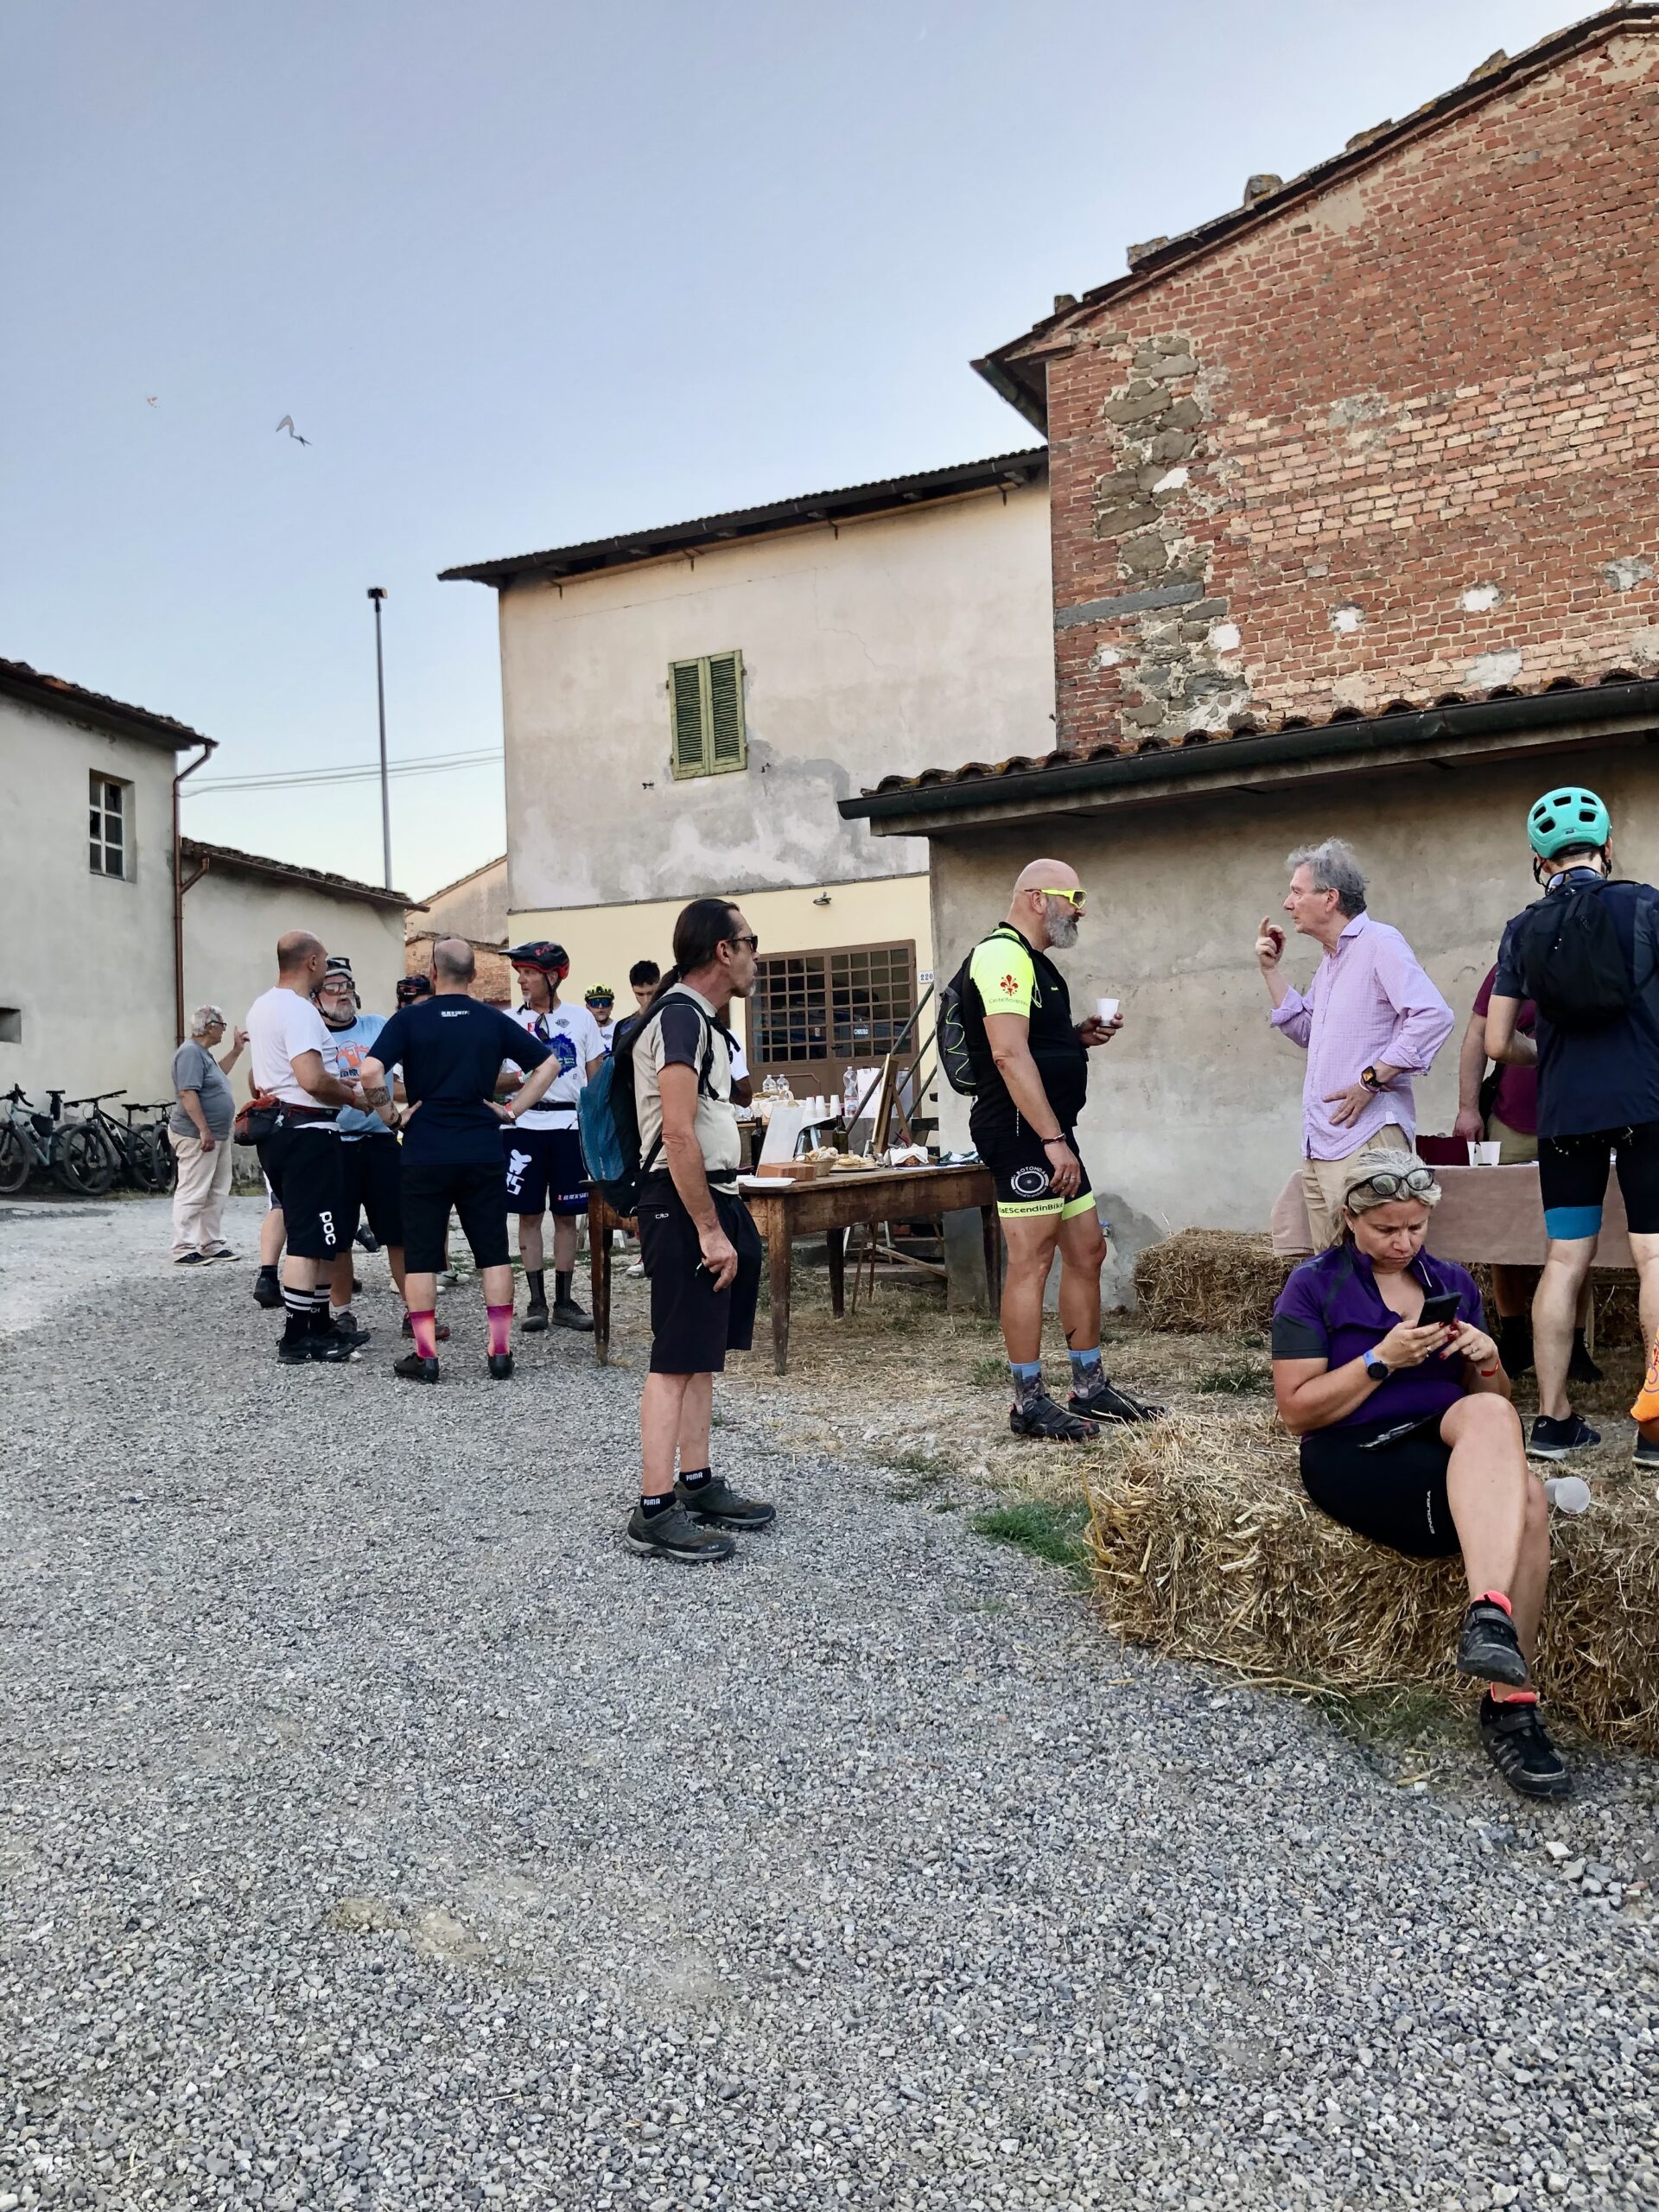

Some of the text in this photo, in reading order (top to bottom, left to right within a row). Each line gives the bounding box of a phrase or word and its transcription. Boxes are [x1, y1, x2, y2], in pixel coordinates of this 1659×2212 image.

[1016, 1166, 1046, 1176] ROTONDA
[319, 1211, 336, 1245] POC
[685, 1471, 703, 1481] PUMA
[643, 1497, 661, 1506] PUMA
[1427, 1490, 1435, 1535] ENDURA
